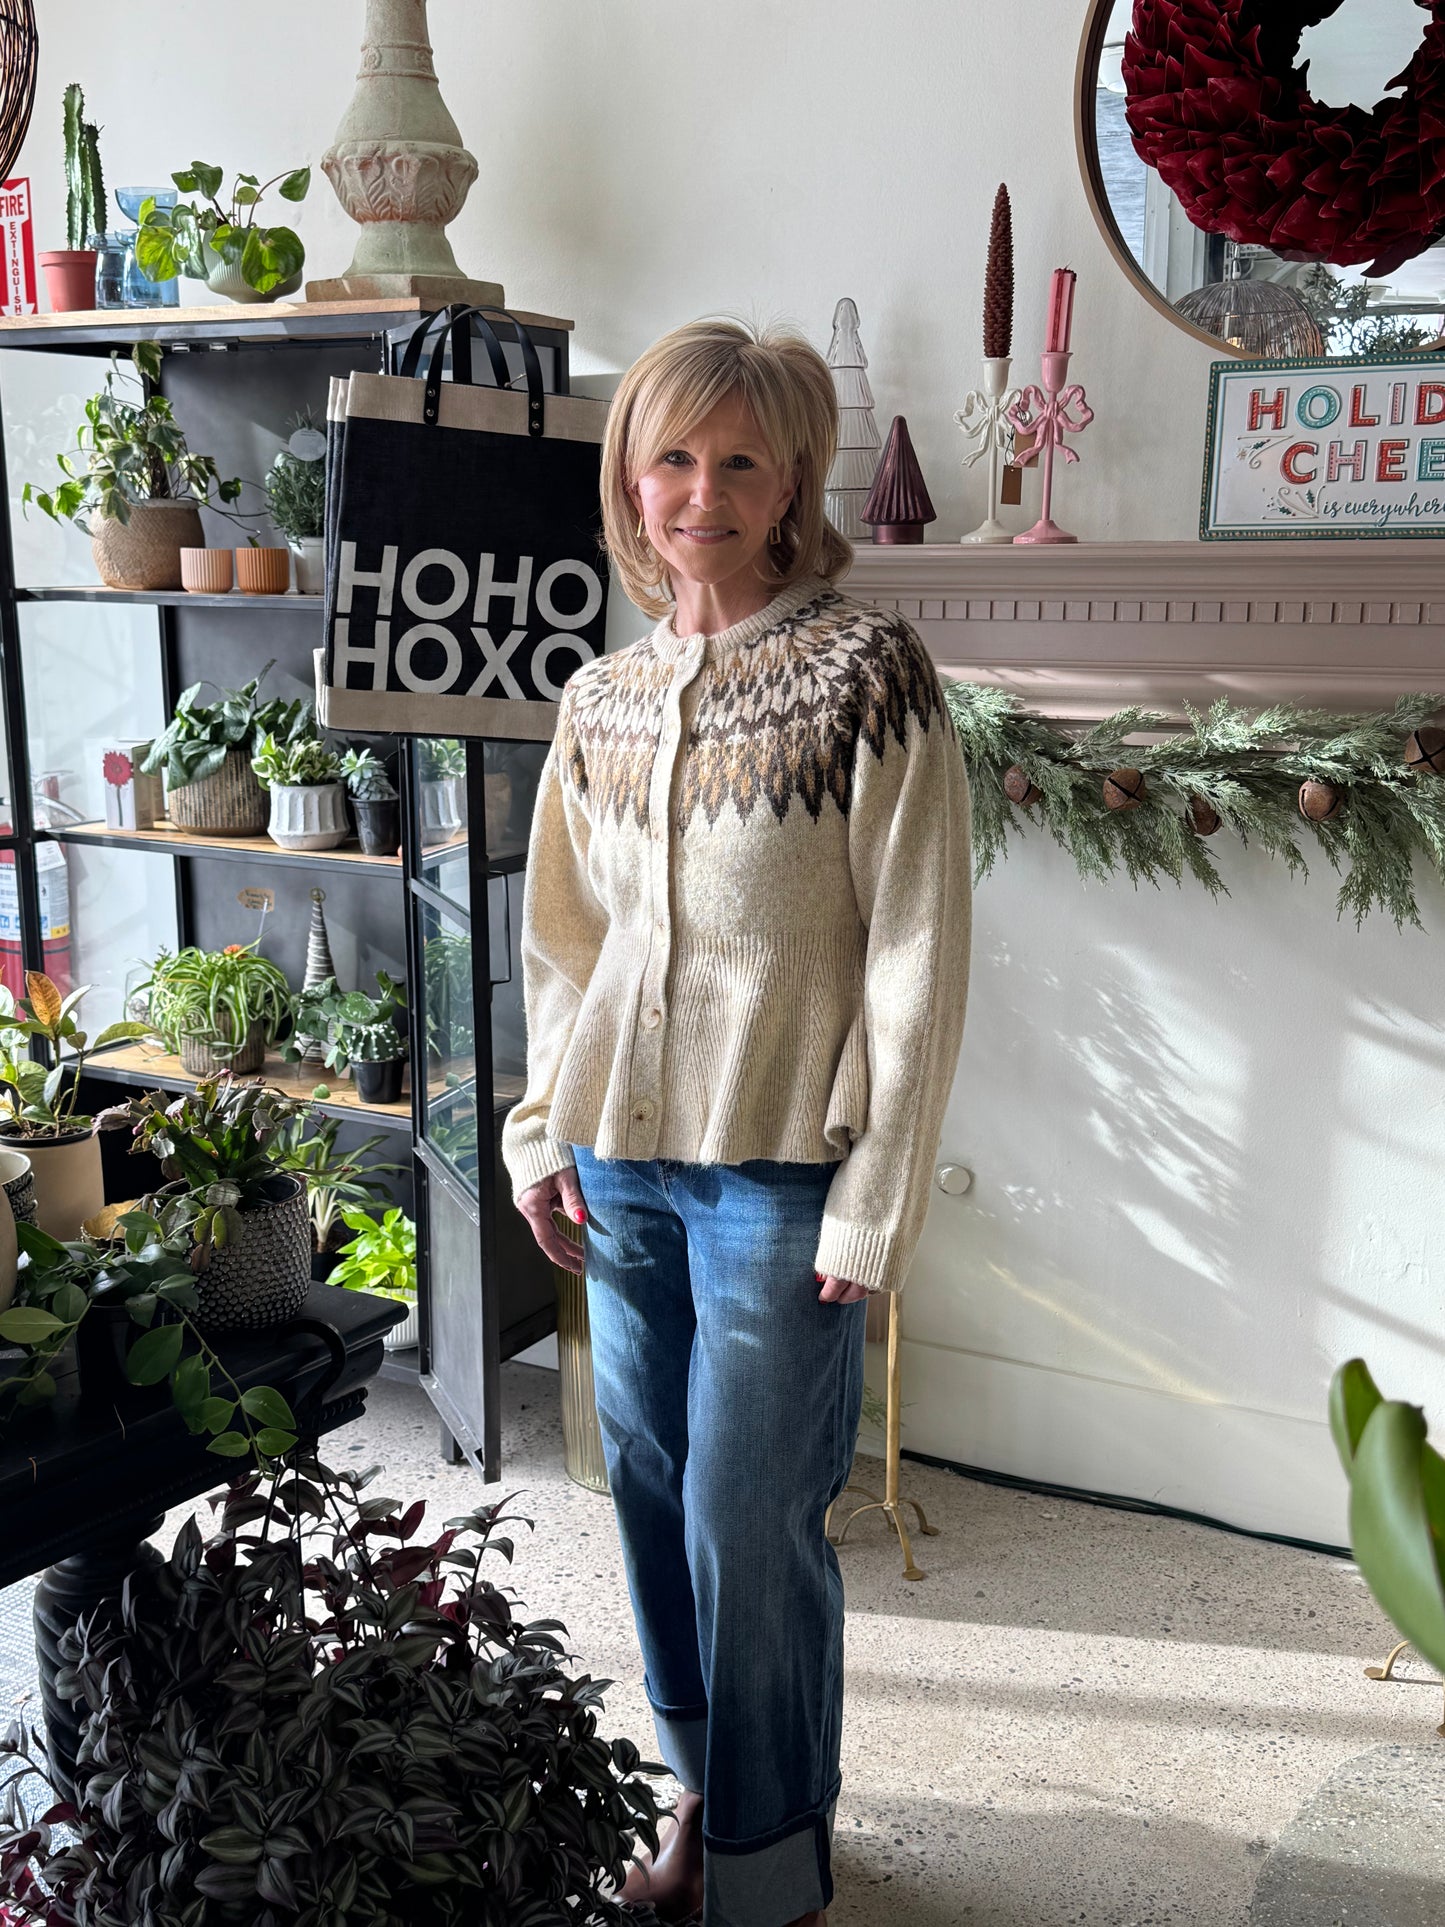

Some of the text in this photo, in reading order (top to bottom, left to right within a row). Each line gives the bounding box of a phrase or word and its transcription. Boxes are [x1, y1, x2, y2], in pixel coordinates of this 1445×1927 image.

[0, 194, 24, 217] FIRE
[9, 221, 22, 316] EXTINGUISH
[1247, 382, 1445, 431] HOLID
[1280, 438, 1445, 485] CHEE
[1323, 501, 1341, 518] is
[336, 540, 603, 630] HOHO
[332, 617, 597, 702] HOXO
